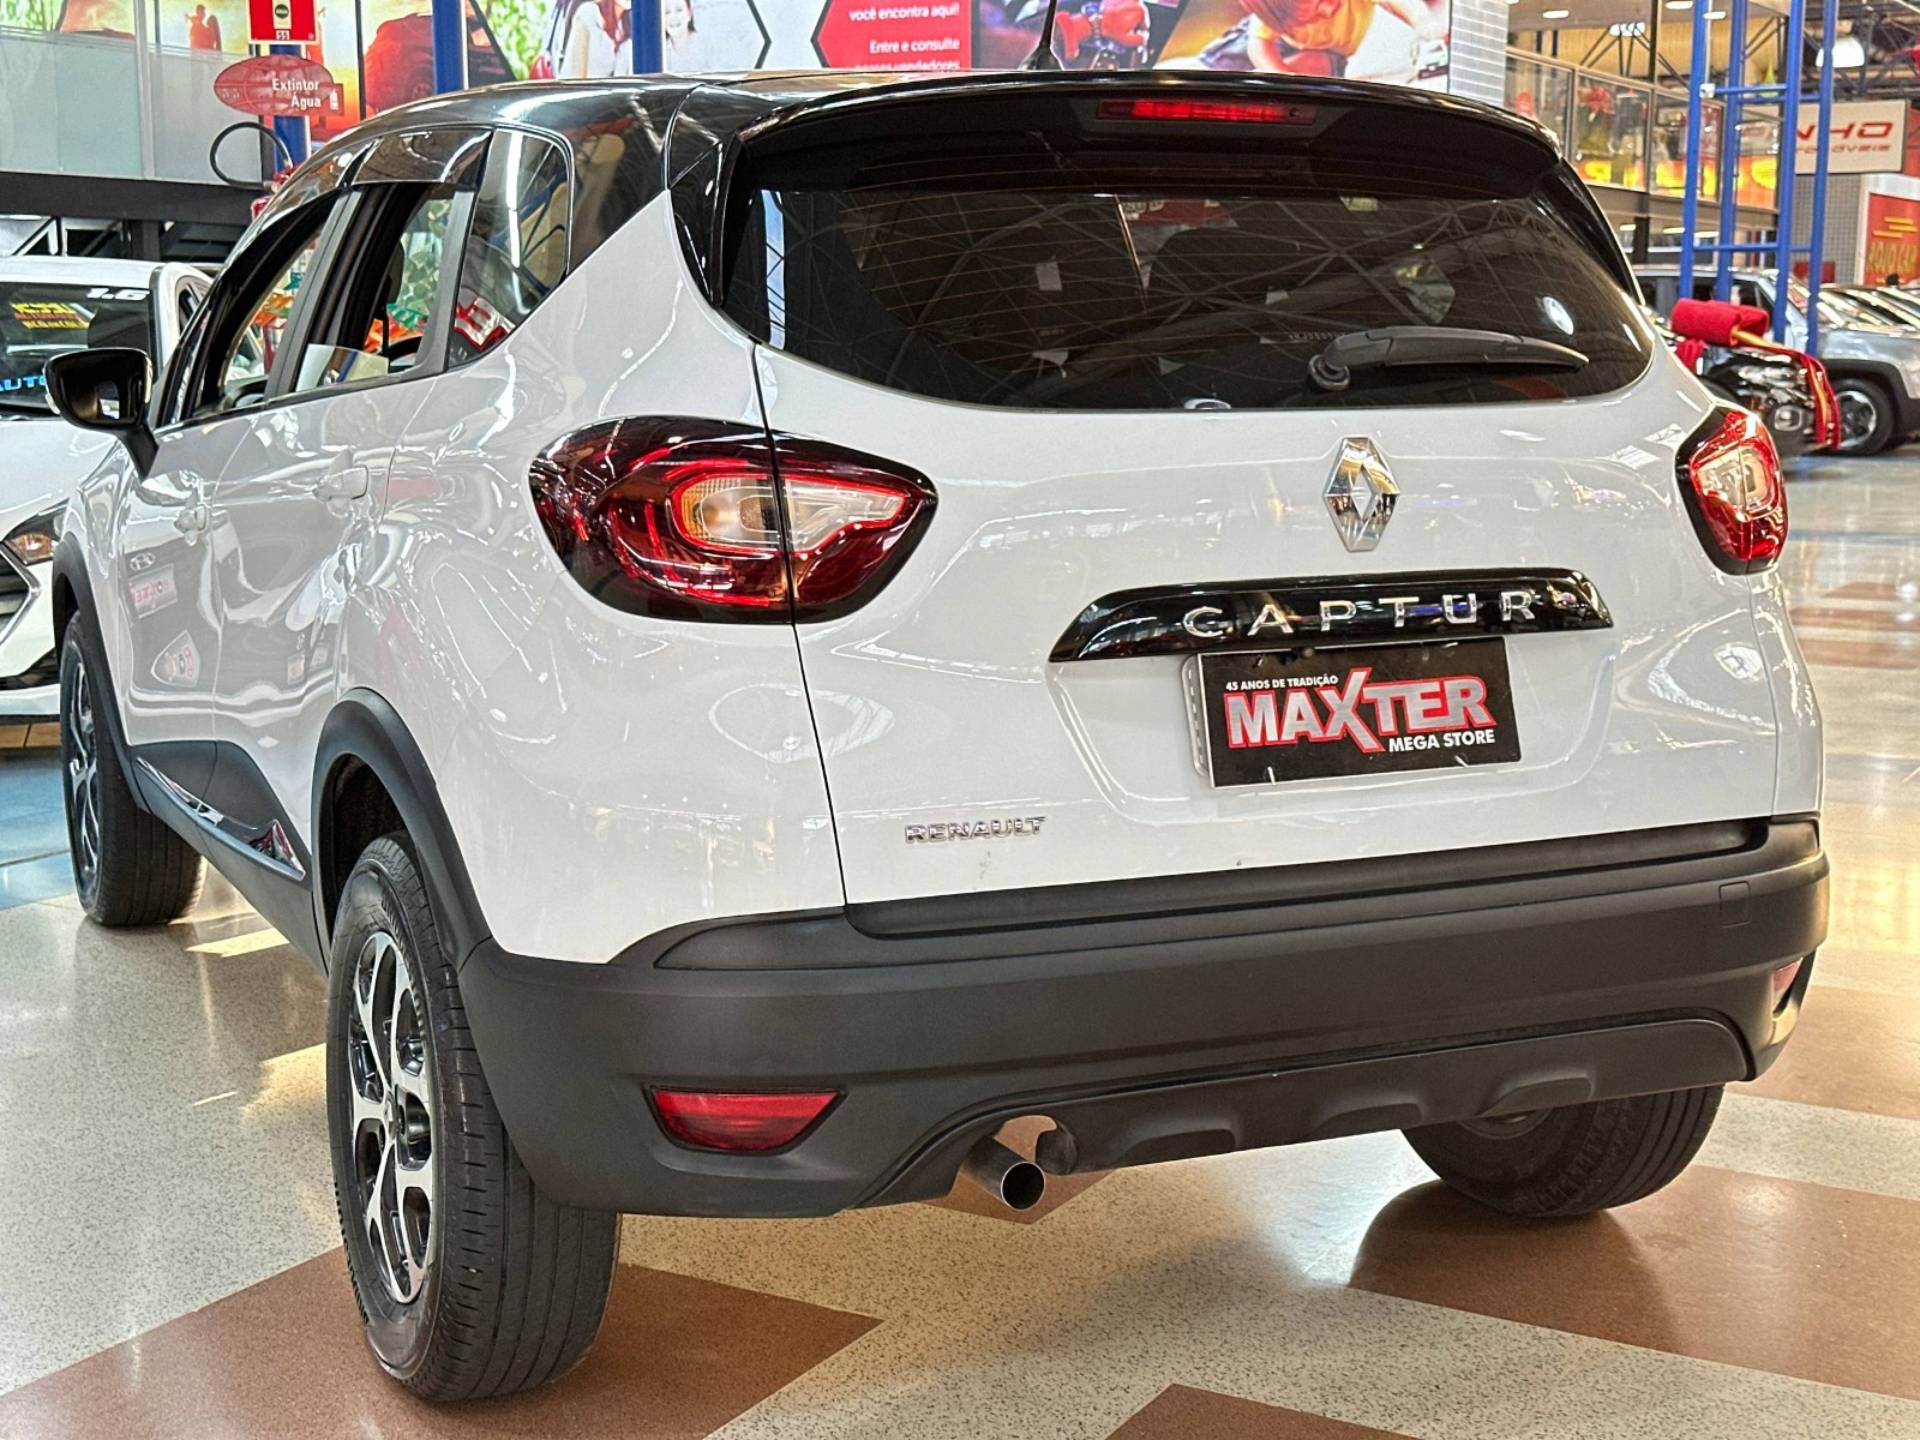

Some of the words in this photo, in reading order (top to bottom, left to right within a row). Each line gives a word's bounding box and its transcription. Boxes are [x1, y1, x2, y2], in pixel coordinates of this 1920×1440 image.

[849, 8, 877, 21] você
[878, 6, 929, 19] encontra
[931, 3, 960, 19] aqui!
[869, 40, 899, 54] Entre
[901, 42, 909, 52] e
[911, 38, 960, 51] consulte
[272, 78, 319, 91] Extintor
[291, 92, 321, 110] Água
[86, 287, 150, 300] 1.6
[1182, 590, 1537, 638] CAPTUR
[1226, 681, 1238, 691] 45
[1240, 679, 1270, 690] ANOS
[1272, 678, 1286, 688] DE
[1287, 673, 1339, 687] TRADIÇÃO
[1224, 667, 1496, 754] MAXTER
[1389, 734, 1440, 752] MEGA
[1443, 729, 1496, 748] STORE
[904, 816, 1047, 842] RENAULT
